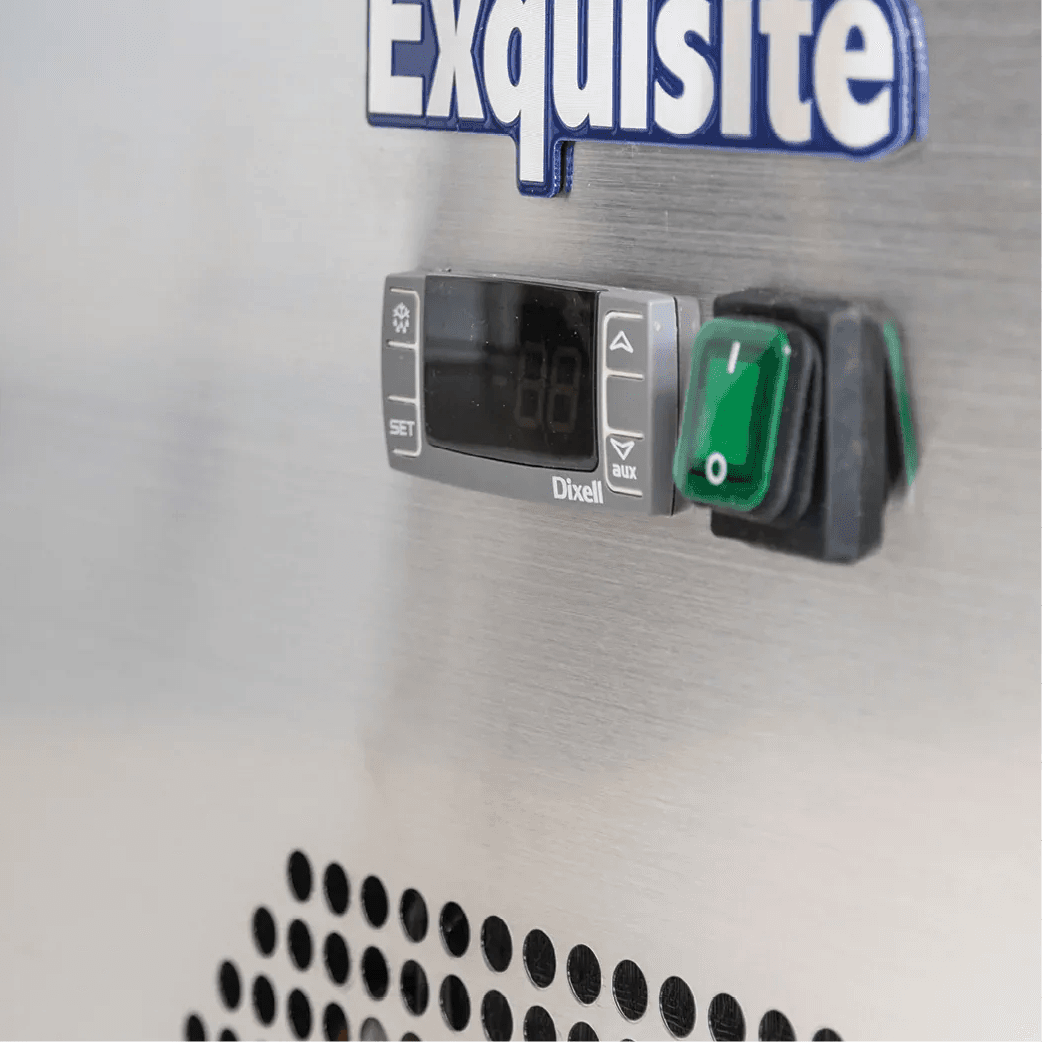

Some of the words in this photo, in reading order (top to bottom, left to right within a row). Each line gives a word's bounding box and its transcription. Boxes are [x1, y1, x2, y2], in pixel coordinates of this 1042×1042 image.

[389, 418, 415, 437] SET
[612, 463, 637, 480] aux
[551, 475, 604, 504] Dixell
